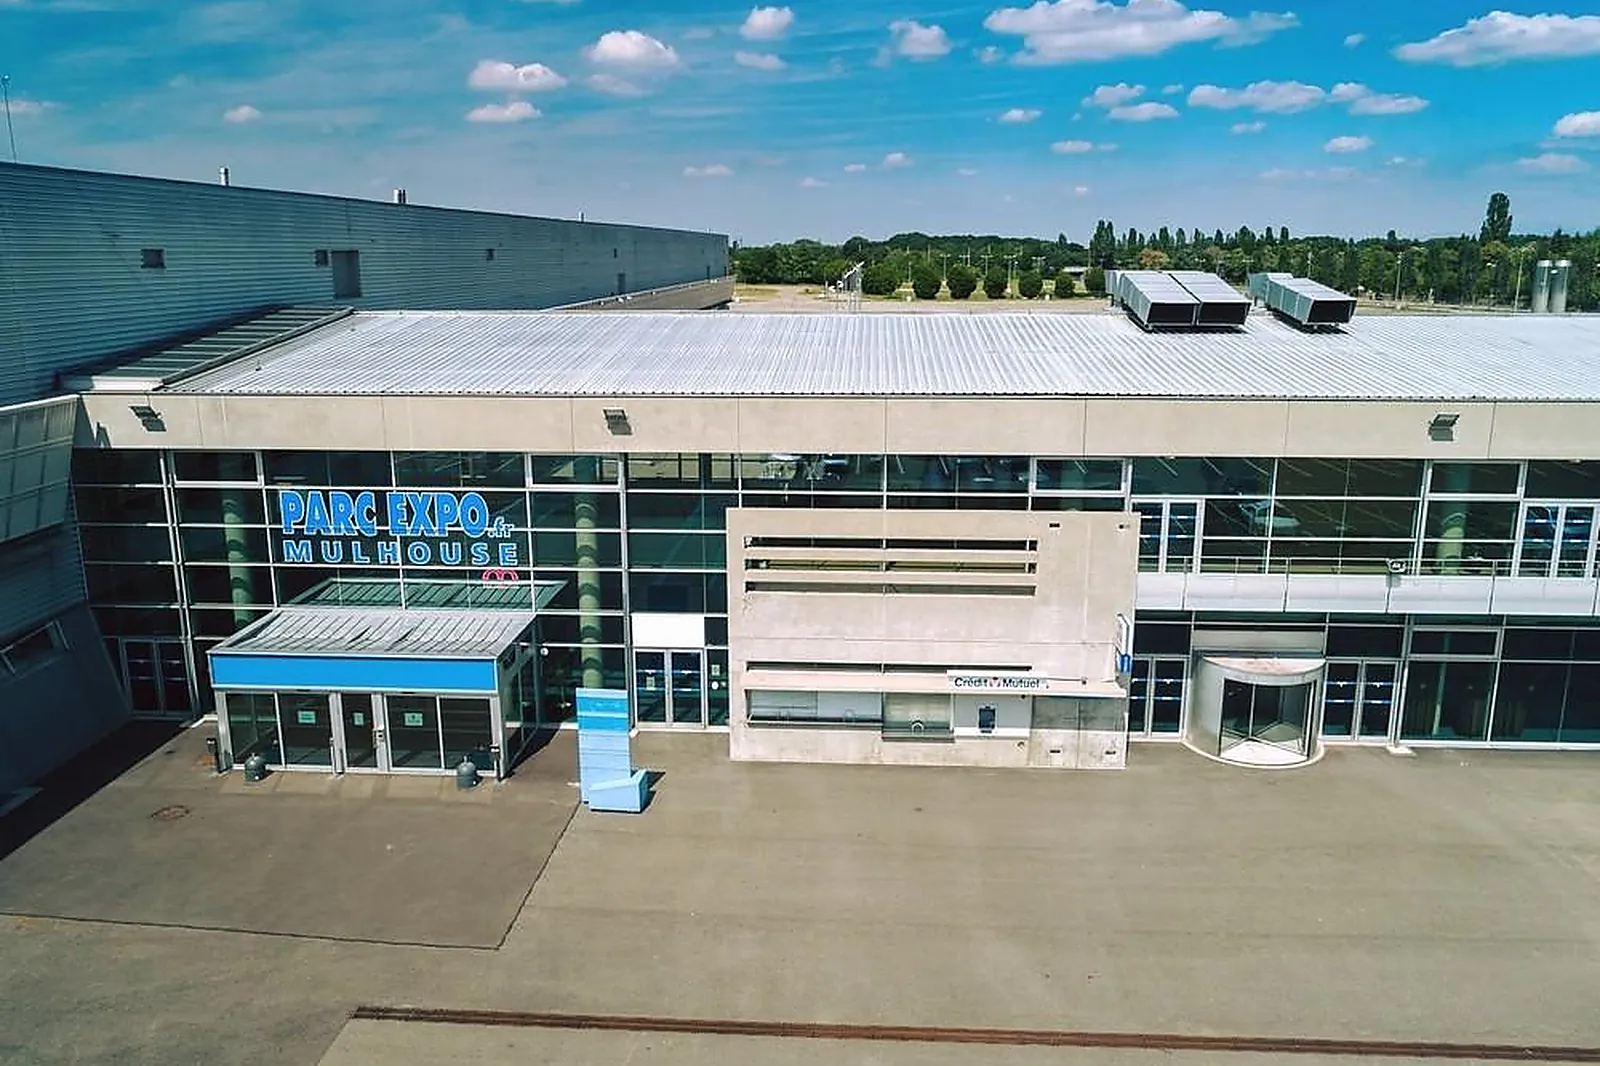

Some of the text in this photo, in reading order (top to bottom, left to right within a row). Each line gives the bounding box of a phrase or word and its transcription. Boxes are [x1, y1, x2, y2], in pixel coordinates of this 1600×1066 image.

[279, 490, 378, 537] PARC
[282, 539, 519, 567] MULHOUSE
[1002, 676, 1040, 689] Mutuel
